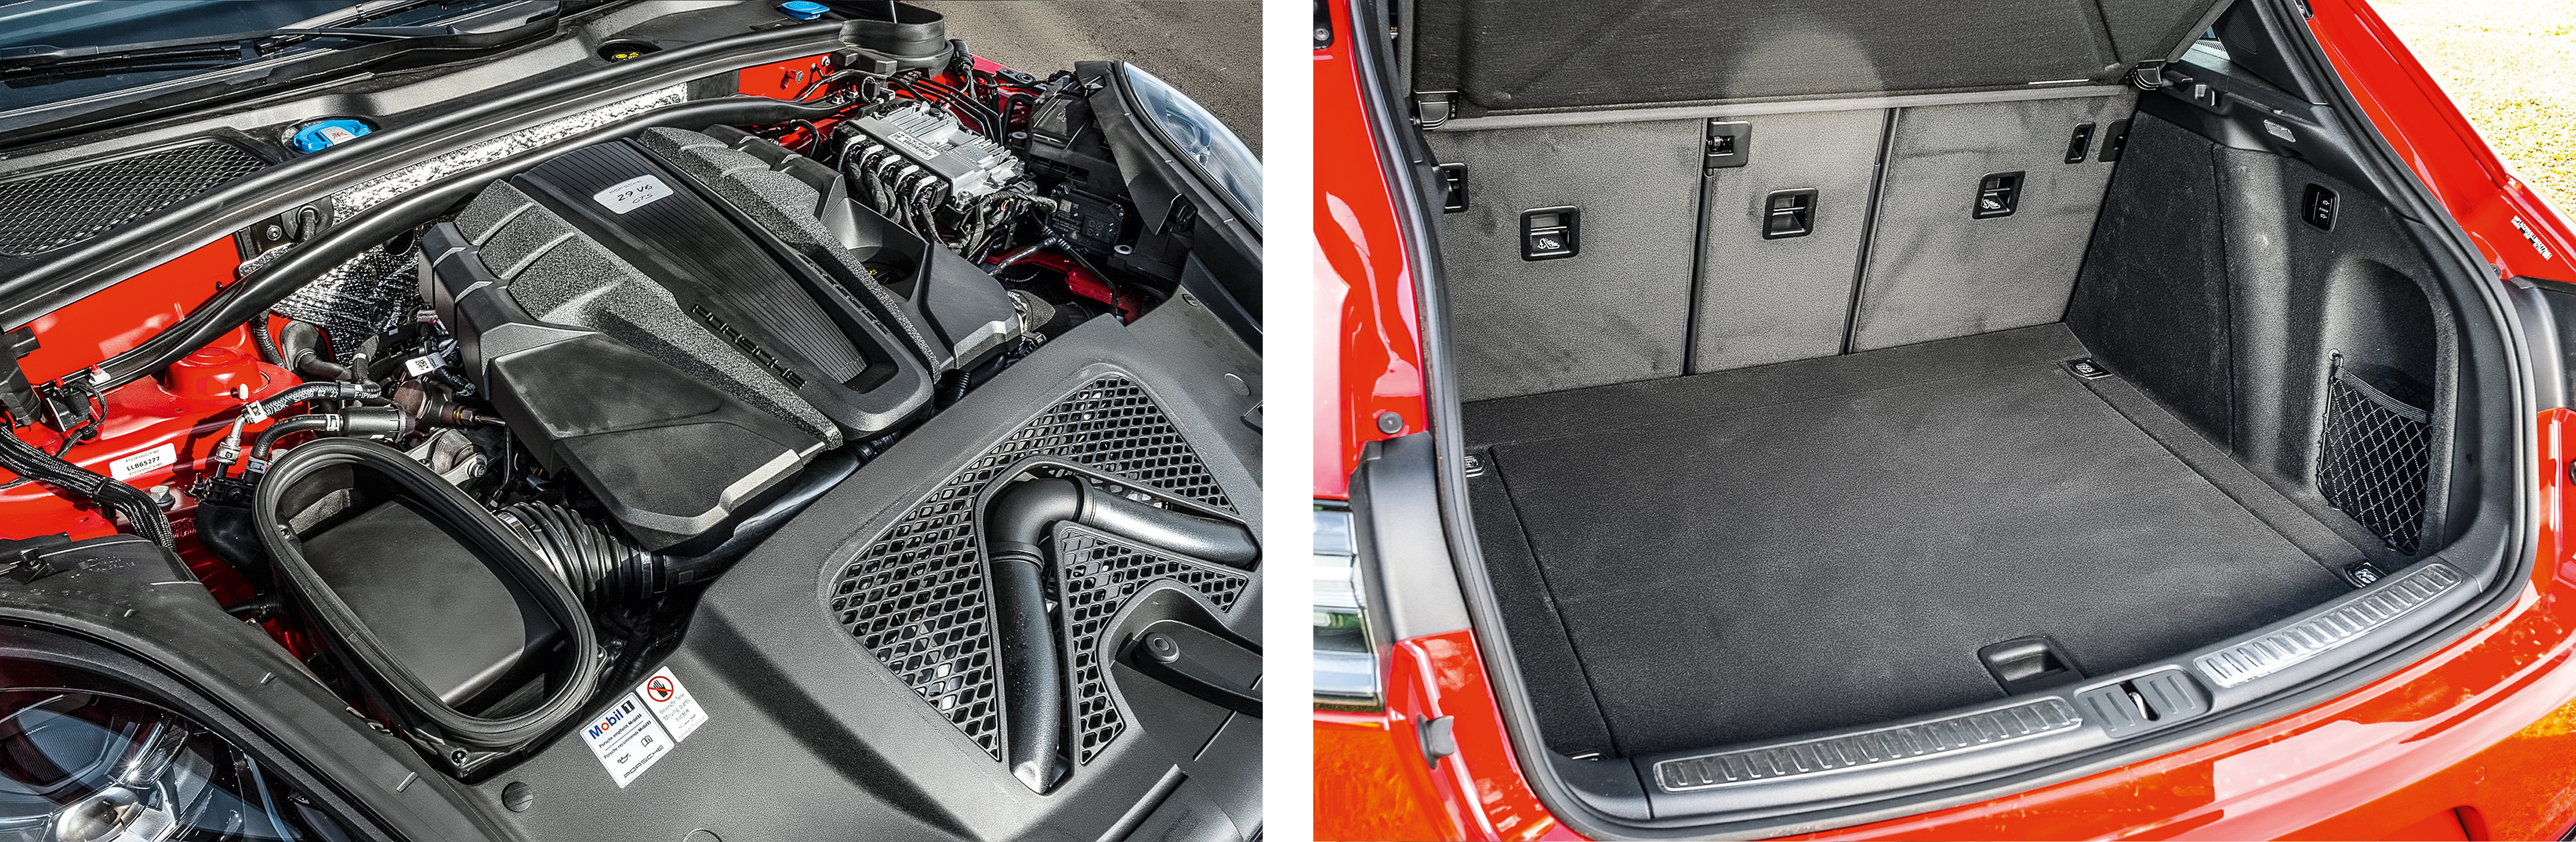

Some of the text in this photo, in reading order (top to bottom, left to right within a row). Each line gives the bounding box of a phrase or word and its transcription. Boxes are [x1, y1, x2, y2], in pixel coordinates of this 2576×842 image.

[633, 193, 652, 204] GTS
[689, 304, 807, 390] PORSCHE
[588, 709, 624, 739] Mobil
[663, 708, 679, 721] Moving
[679, 699, 691, 710] parts
[599, 736, 613, 748] Porsche
[613, 724, 629, 738] empfiehlt
[604, 747, 618, 759] Porsche
[617, 731, 639, 749] recommends
[623, 744, 665, 778] PORSCHE
